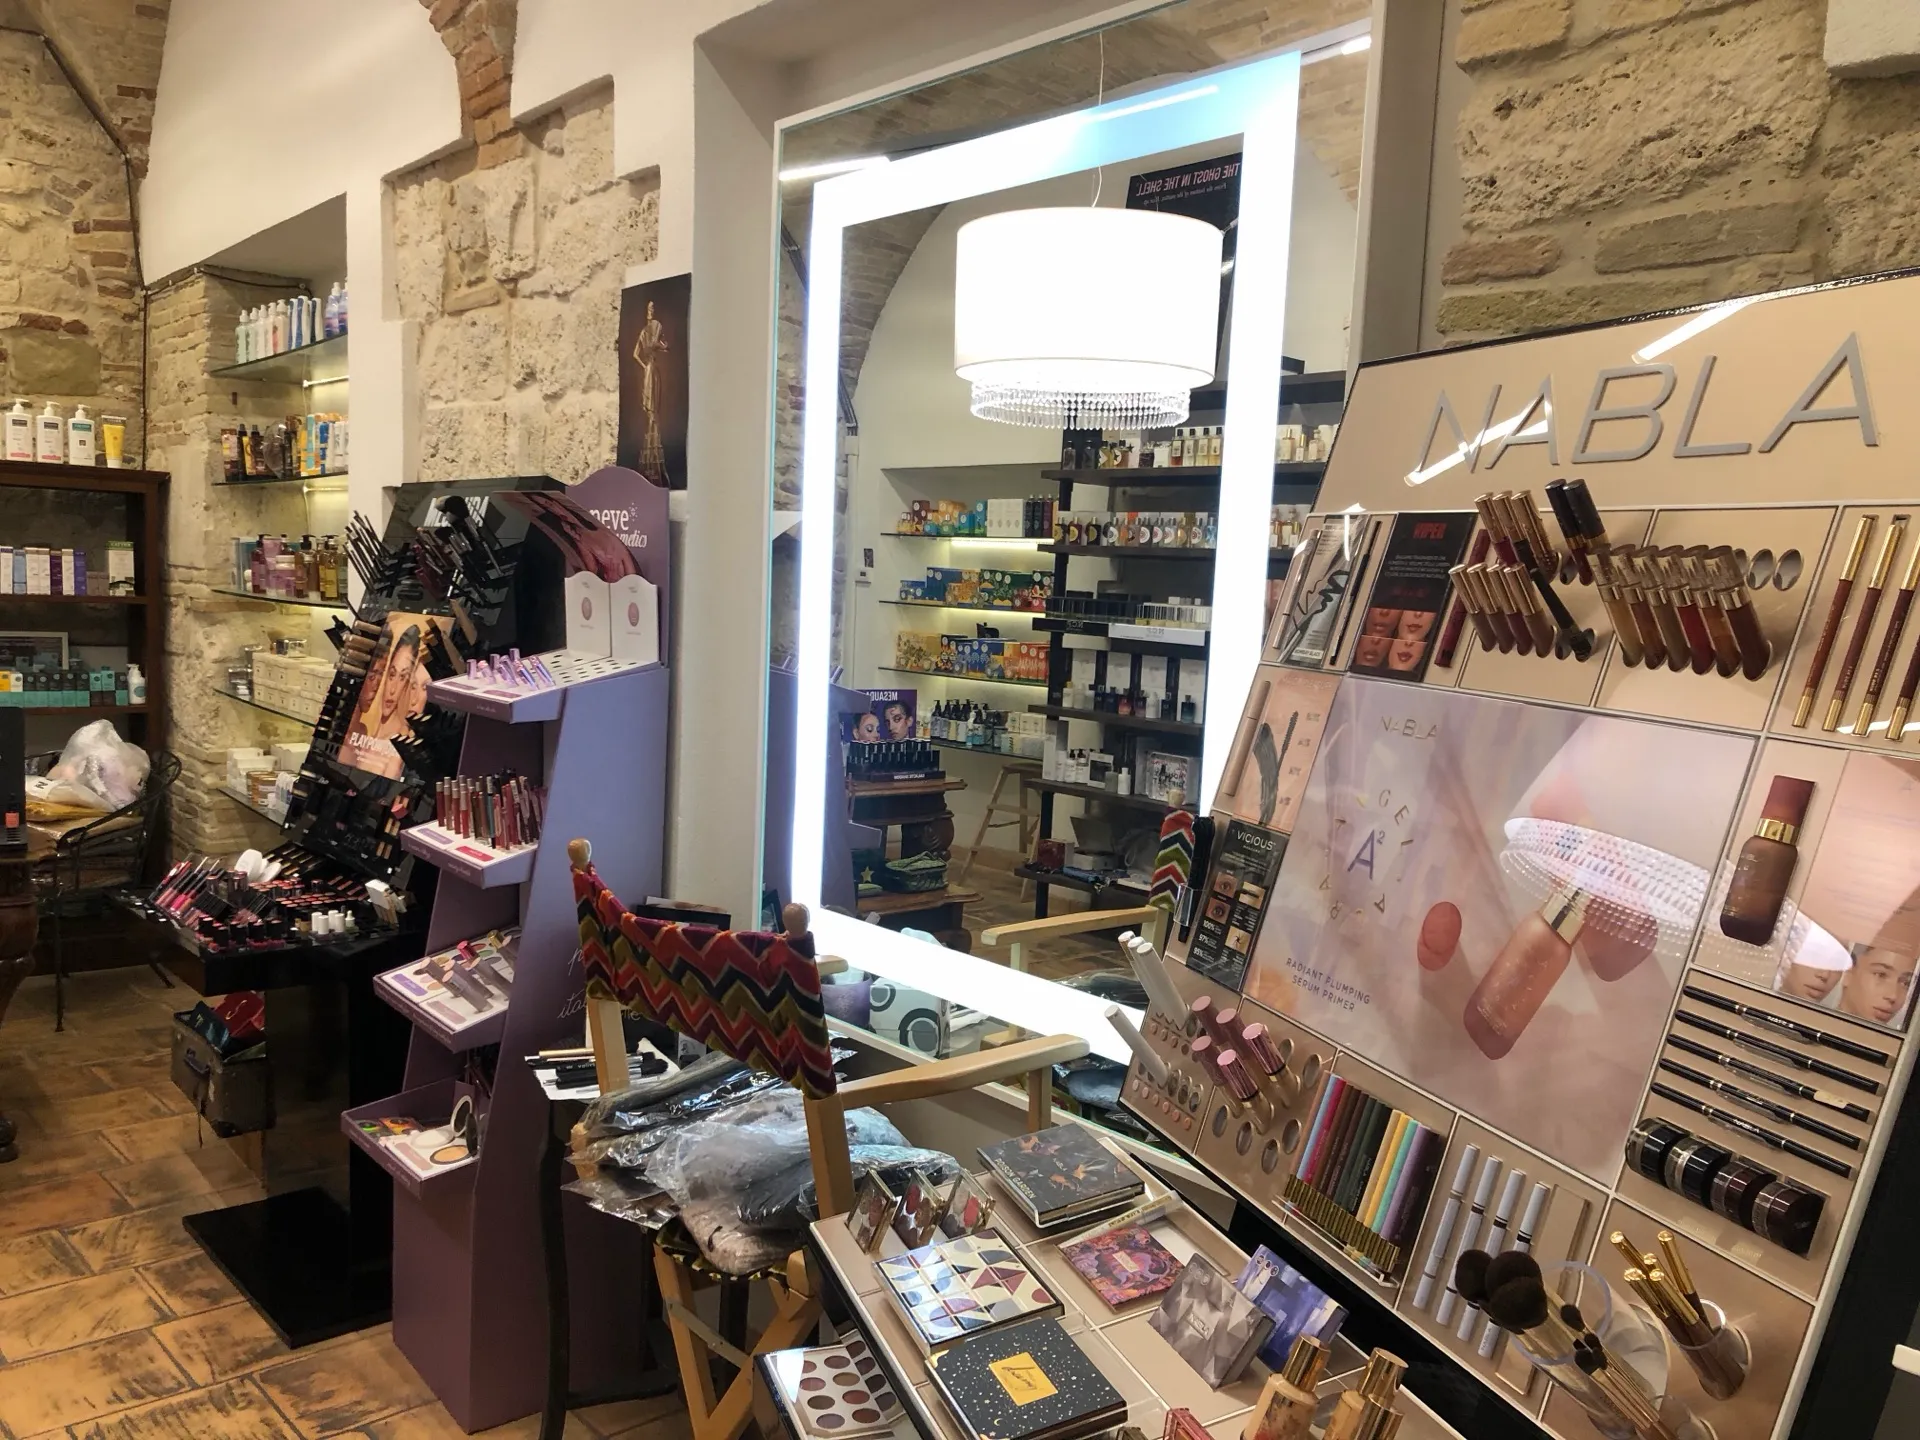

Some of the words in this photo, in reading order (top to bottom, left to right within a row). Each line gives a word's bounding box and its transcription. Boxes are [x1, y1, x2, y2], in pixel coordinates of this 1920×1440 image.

[1415, 331, 1880, 474] NABLA
[589, 508, 630, 530] neve
[1237, 829, 1274, 852] VICIOUS
[1203, 920, 1215, 932] 100%
[1286, 957, 1323, 982] RADIANT
[1325, 976, 1371, 1005] PLUMPING
[1291, 974, 1321, 996] SERUM
[1322, 989, 1356, 1013] PRIMER
[994, 1158, 1015, 1177] POISON
[1013, 1176, 1037, 1199] GARDEN
